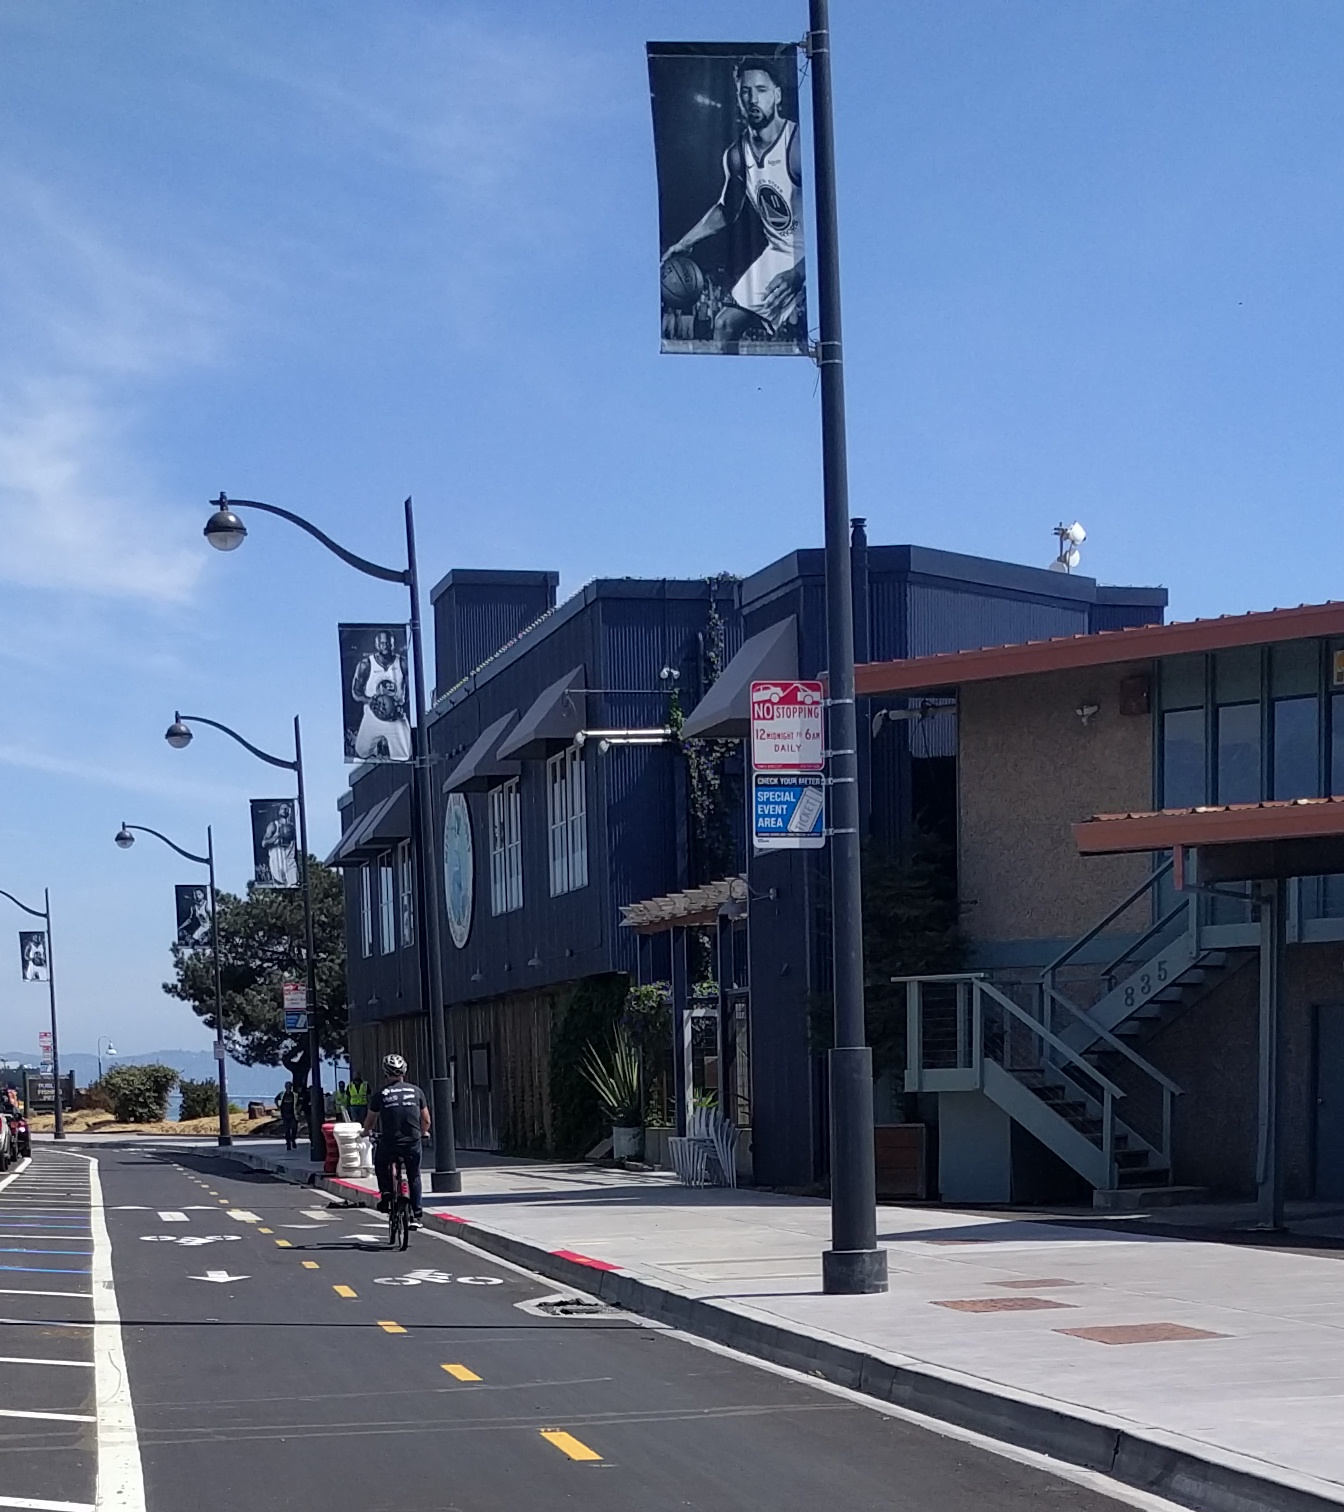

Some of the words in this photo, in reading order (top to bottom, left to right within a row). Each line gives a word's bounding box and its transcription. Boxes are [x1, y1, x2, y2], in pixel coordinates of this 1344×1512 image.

[754, 703, 773, 719] NO
[776, 706, 820, 719] STOPPING
[774, 744, 802, 752] DAILY
[757, 777, 778, 785] CHECK
[780, 777, 797, 785] YOUR
[799, 776, 820, 785] METER
[757, 791, 796, 802] SPECIAL
[757, 804, 787, 815] EVENT
[795, 799, 817, 831] TICKET
[757, 817, 783, 828] AREA
[1125, 960, 1168, 1008] 835
